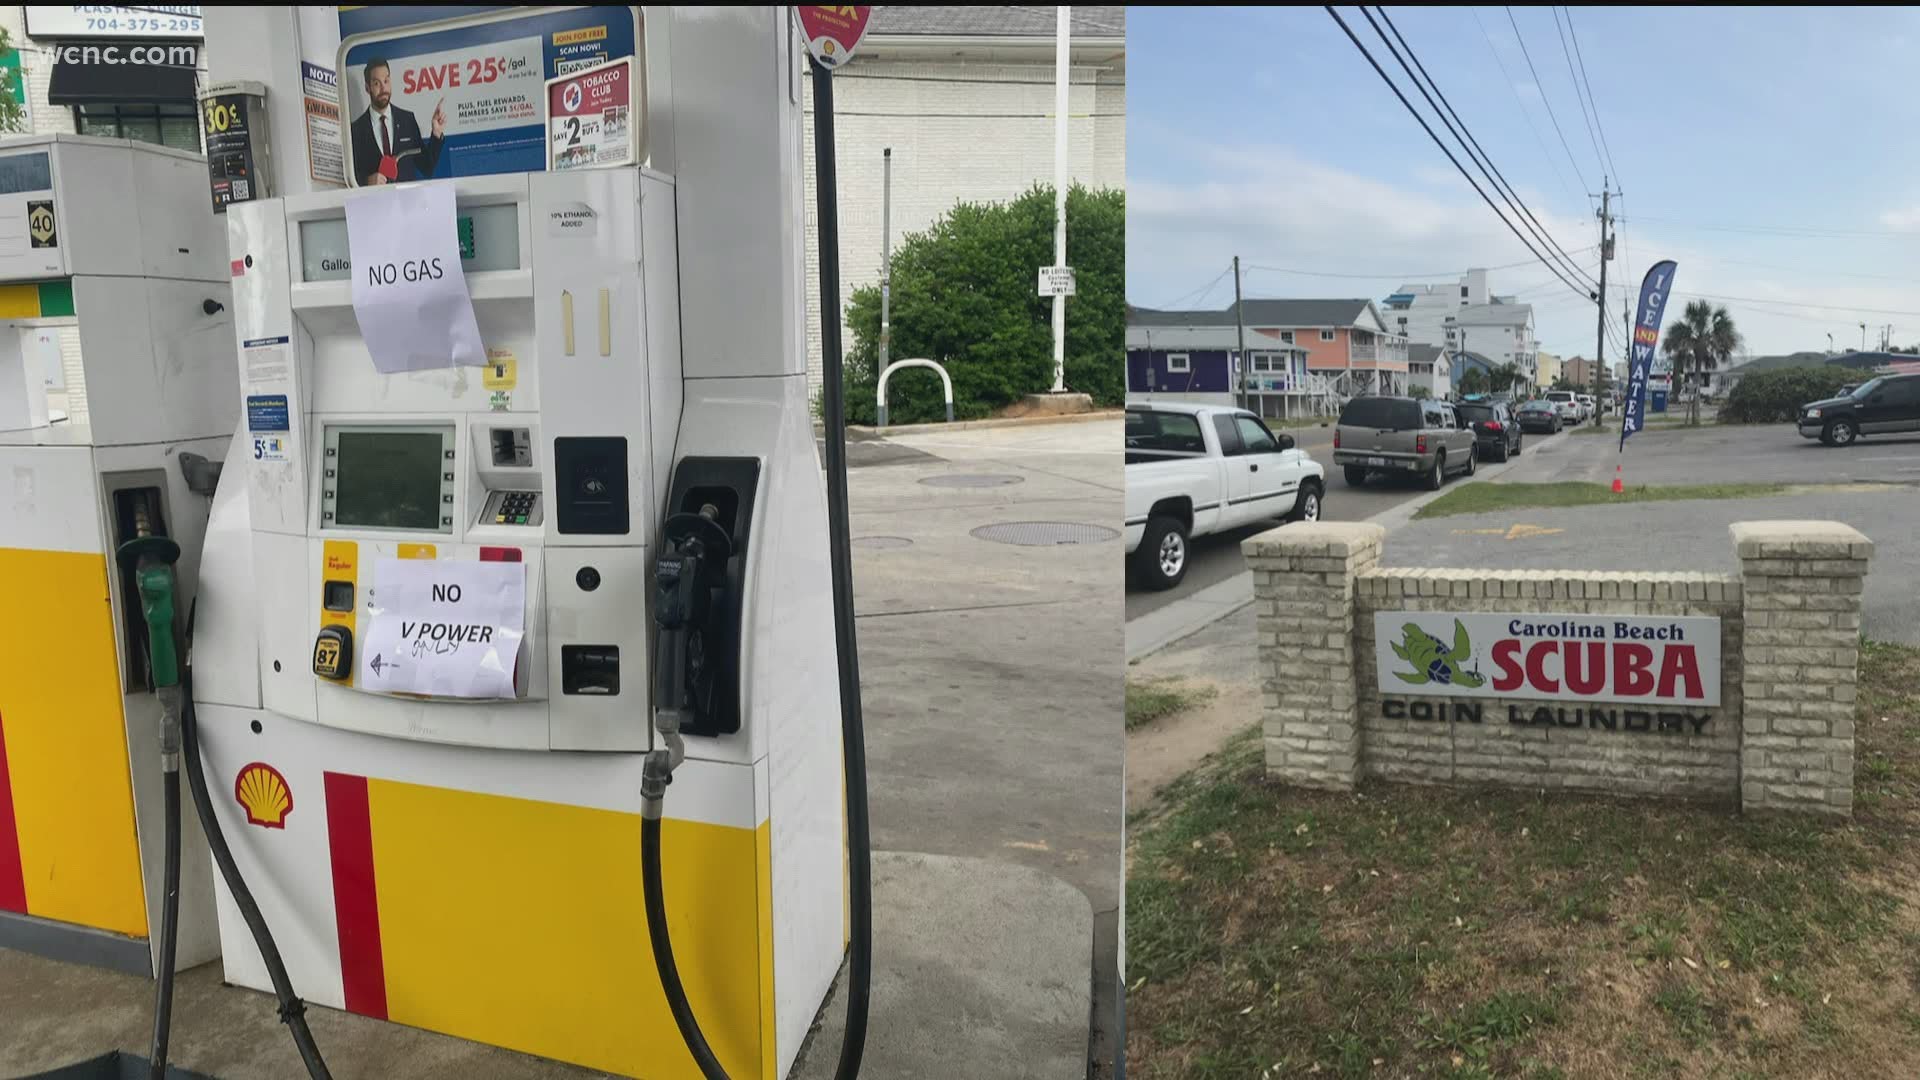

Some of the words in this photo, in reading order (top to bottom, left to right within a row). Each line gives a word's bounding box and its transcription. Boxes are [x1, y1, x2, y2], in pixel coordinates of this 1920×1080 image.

[556, 34, 572, 43] JOIN
[573, 31, 587, 40] FOR
[588, 29, 604, 39] FREE
[560, 45, 579, 55] SCAN
[580, 43, 601, 52] NOW!
[403, 62, 461, 95] SAVE
[583, 70, 620, 88] TOBACCO
[591, 84, 611, 98] CLUB
[477, 99, 492, 107] FUEL
[493, 95, 526, 105] REWARDS
[458, 108, 489, 118] MEMBERS
[490, 105, 507, 114] SAVE
[553, 131, 568, 142] SAVE
[32, 215, 53, 233] 40
[561, 220, 583, 228] ADDED
[368, 263, 398, 287] NO
[403, 257, 443, 282] GAS
[1643, 274, 1664, 326] ICE
[1635, 329, 1656, 342] AND
[1623, 345, 1651, 432] WATER
[328, 562, 352, 570] Regular
[432, 583, 462, 603] NO
[402, 621, 416, 639] V
[418, 622, 493, 643] POWER
[1508, 620, 1605, 638] Carolina
[1613, 622, 1684, 641] Beach
[317, 649, 338, 665] 87
[1491, 639, 1704, 699] SCUBA
[1382, 700, 1482, 723] COIN
[1508, 704, 1712, 734] LAUNDRY
